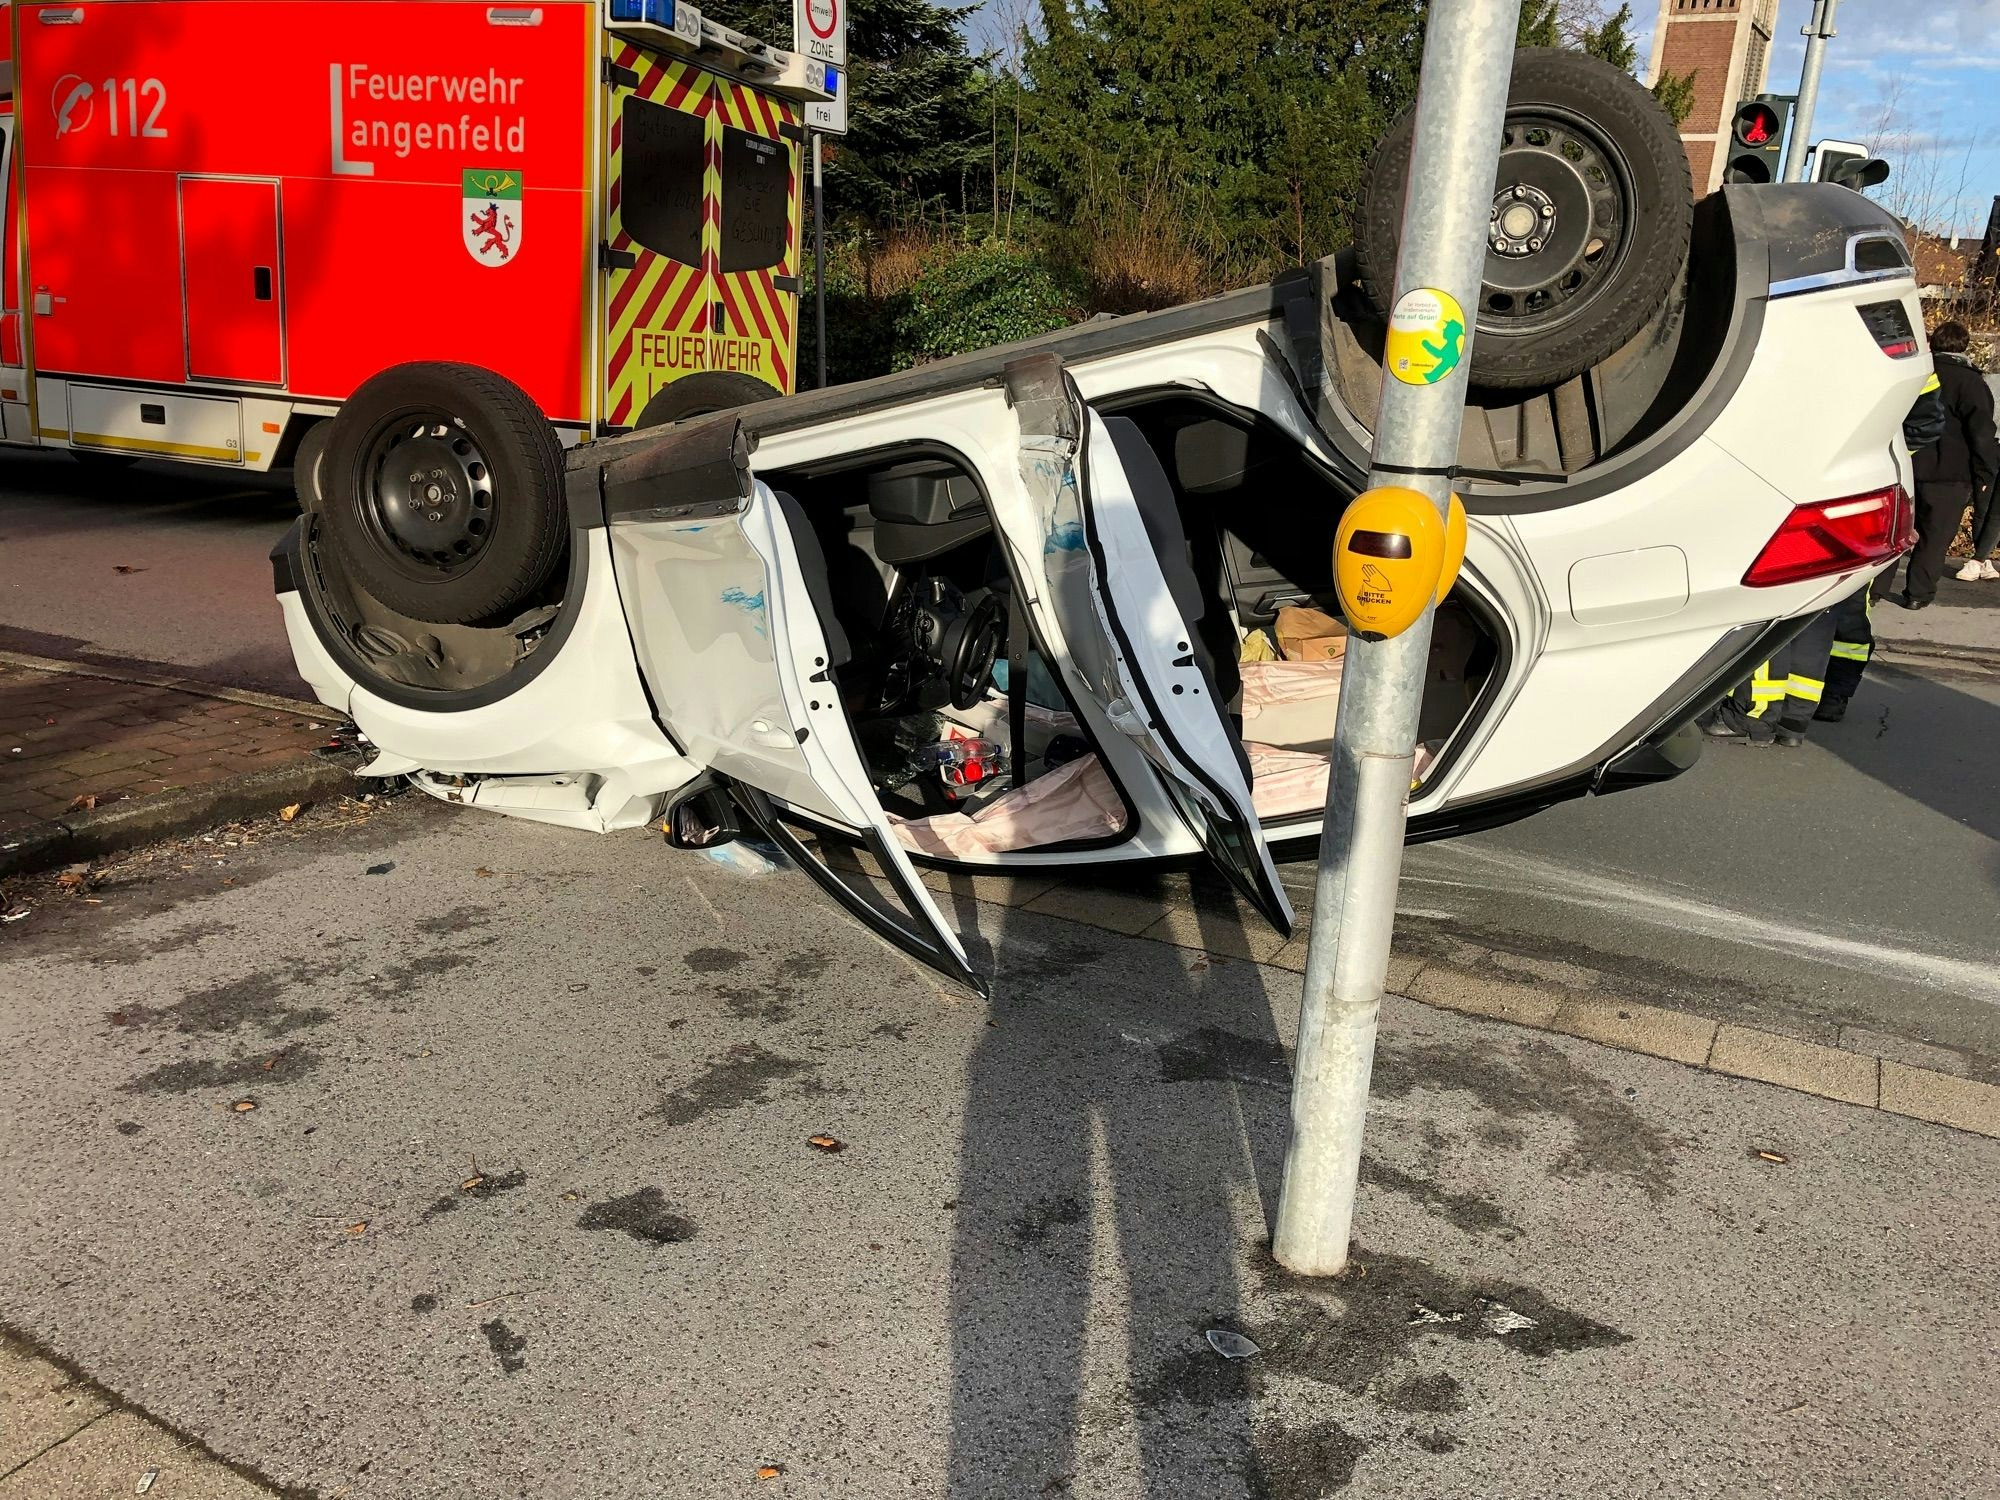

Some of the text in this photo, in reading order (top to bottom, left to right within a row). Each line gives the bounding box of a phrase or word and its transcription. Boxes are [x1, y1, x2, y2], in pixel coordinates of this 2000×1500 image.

[811, 2, 833, 18] Umwelt
[810, 39, 834, 58] ZONE
[350, 64, 524, 104] Feuerwehr
[103, 78, 168, 138] 112
[816, 107, 831, 122] frei
[640, 333, 761, 372] FEUERWEHR
[225, 439, 238, 448] G3
